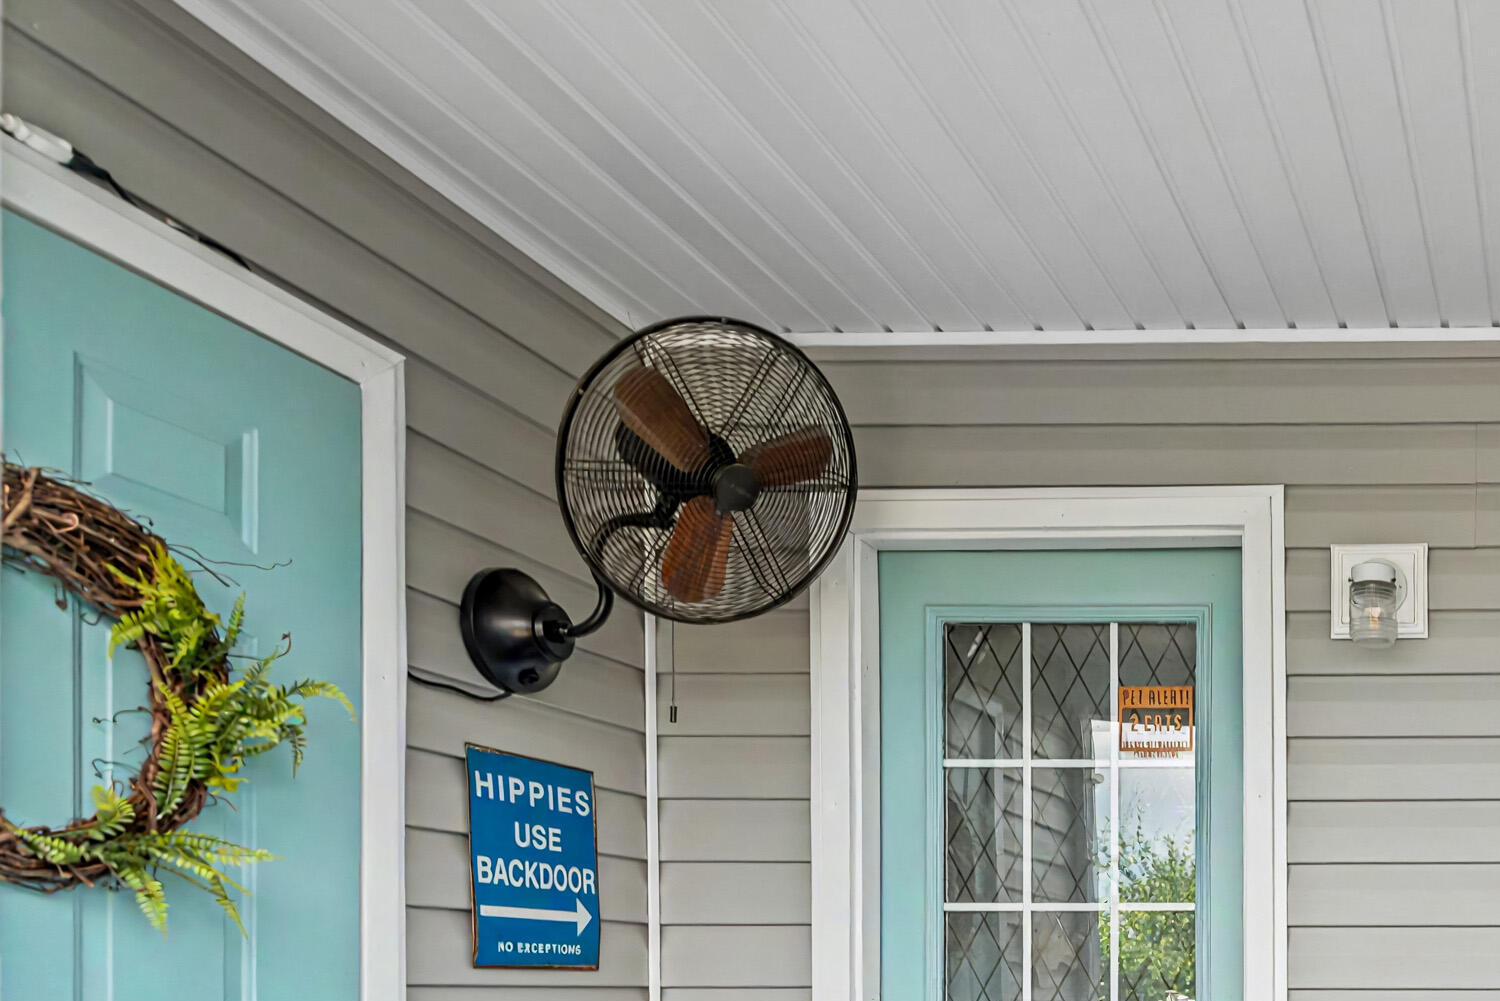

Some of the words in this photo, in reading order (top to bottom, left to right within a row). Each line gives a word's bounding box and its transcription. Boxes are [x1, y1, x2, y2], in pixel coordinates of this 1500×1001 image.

[1122, 689, 1143, 705] PET
[1148, 689, 1189, 705] ALERT!
[1129, 713, 1139, 732] 2
[1144, 713, 1182, 732] CATS
[474, 769, 591, 817] HIPPIES
[514, 821, 562, 852] USE
[476, 855, 596, 895] BACKDOOR
[497, 941, 514, 953] NO
[517, 941, 582, 956] EXCEPTIONS
